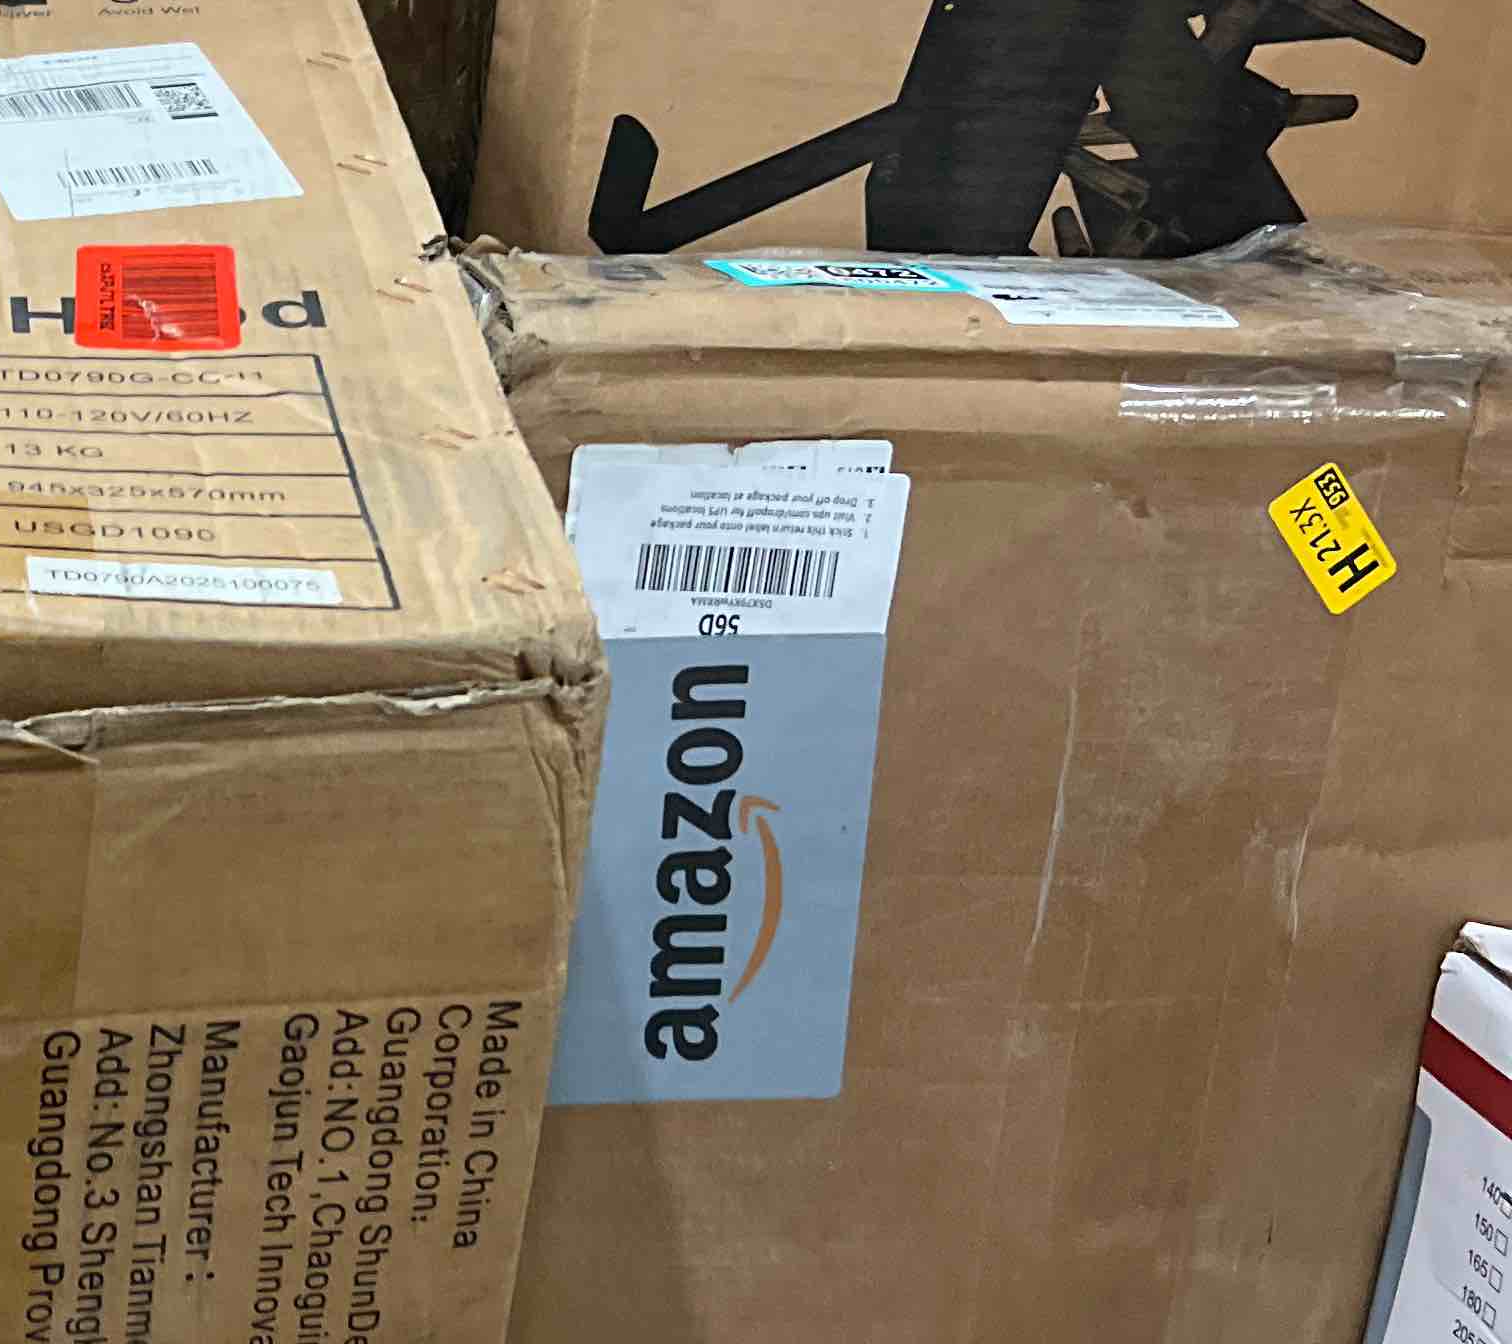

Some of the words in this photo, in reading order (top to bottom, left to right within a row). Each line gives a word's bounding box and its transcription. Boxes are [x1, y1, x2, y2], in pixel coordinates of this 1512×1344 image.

[97, 6, 157, 17] Avoid
[163, 5, 200, 15] Wet
[10, 288, 328, 335] Hd
[4, 441, 43, 457] 13
[55, 444, 105, 459] KG
[660, 505, 706, 516] locations
[690, 492, 730, 500] location
[747, 490, 789, 503] package
[833, 496, 858, 508] Drop
[1316, 472, 1348, 508] 953
[13, 518, 217, 543] USGD1090
[650, 518, 692, 529] package
[773, 525, 804, 535] return
[1289, 497, 1341, 562] 21.3X
[1328, 543, 1379, 593] H
[698, 614, 740, 636] 56D
[644, 662, 751, 1063] amazon
[474, 1001, 523, 1099] Made
[91, 1028, 133, 1114] Add:
[268, 1013, 318, 1142] Gaojun
[132, 1025, 186, 1227] Zhongshan
[356, 1007, 421, 1214] Guangdong
[411, 1004, 473, 1224] Corporation:
[468, 1109, 506, 1139] in
[21, 1031, 82, 1252] Guangdong
[82, 1122, 124, 1210] No.3
[261, 1151, 304, 1234] Tech
[451, 1151, 498, 1249] China
[1480, 1176, 1502, 1206] 140
[1468, 1249, 1488, 1279] 165
